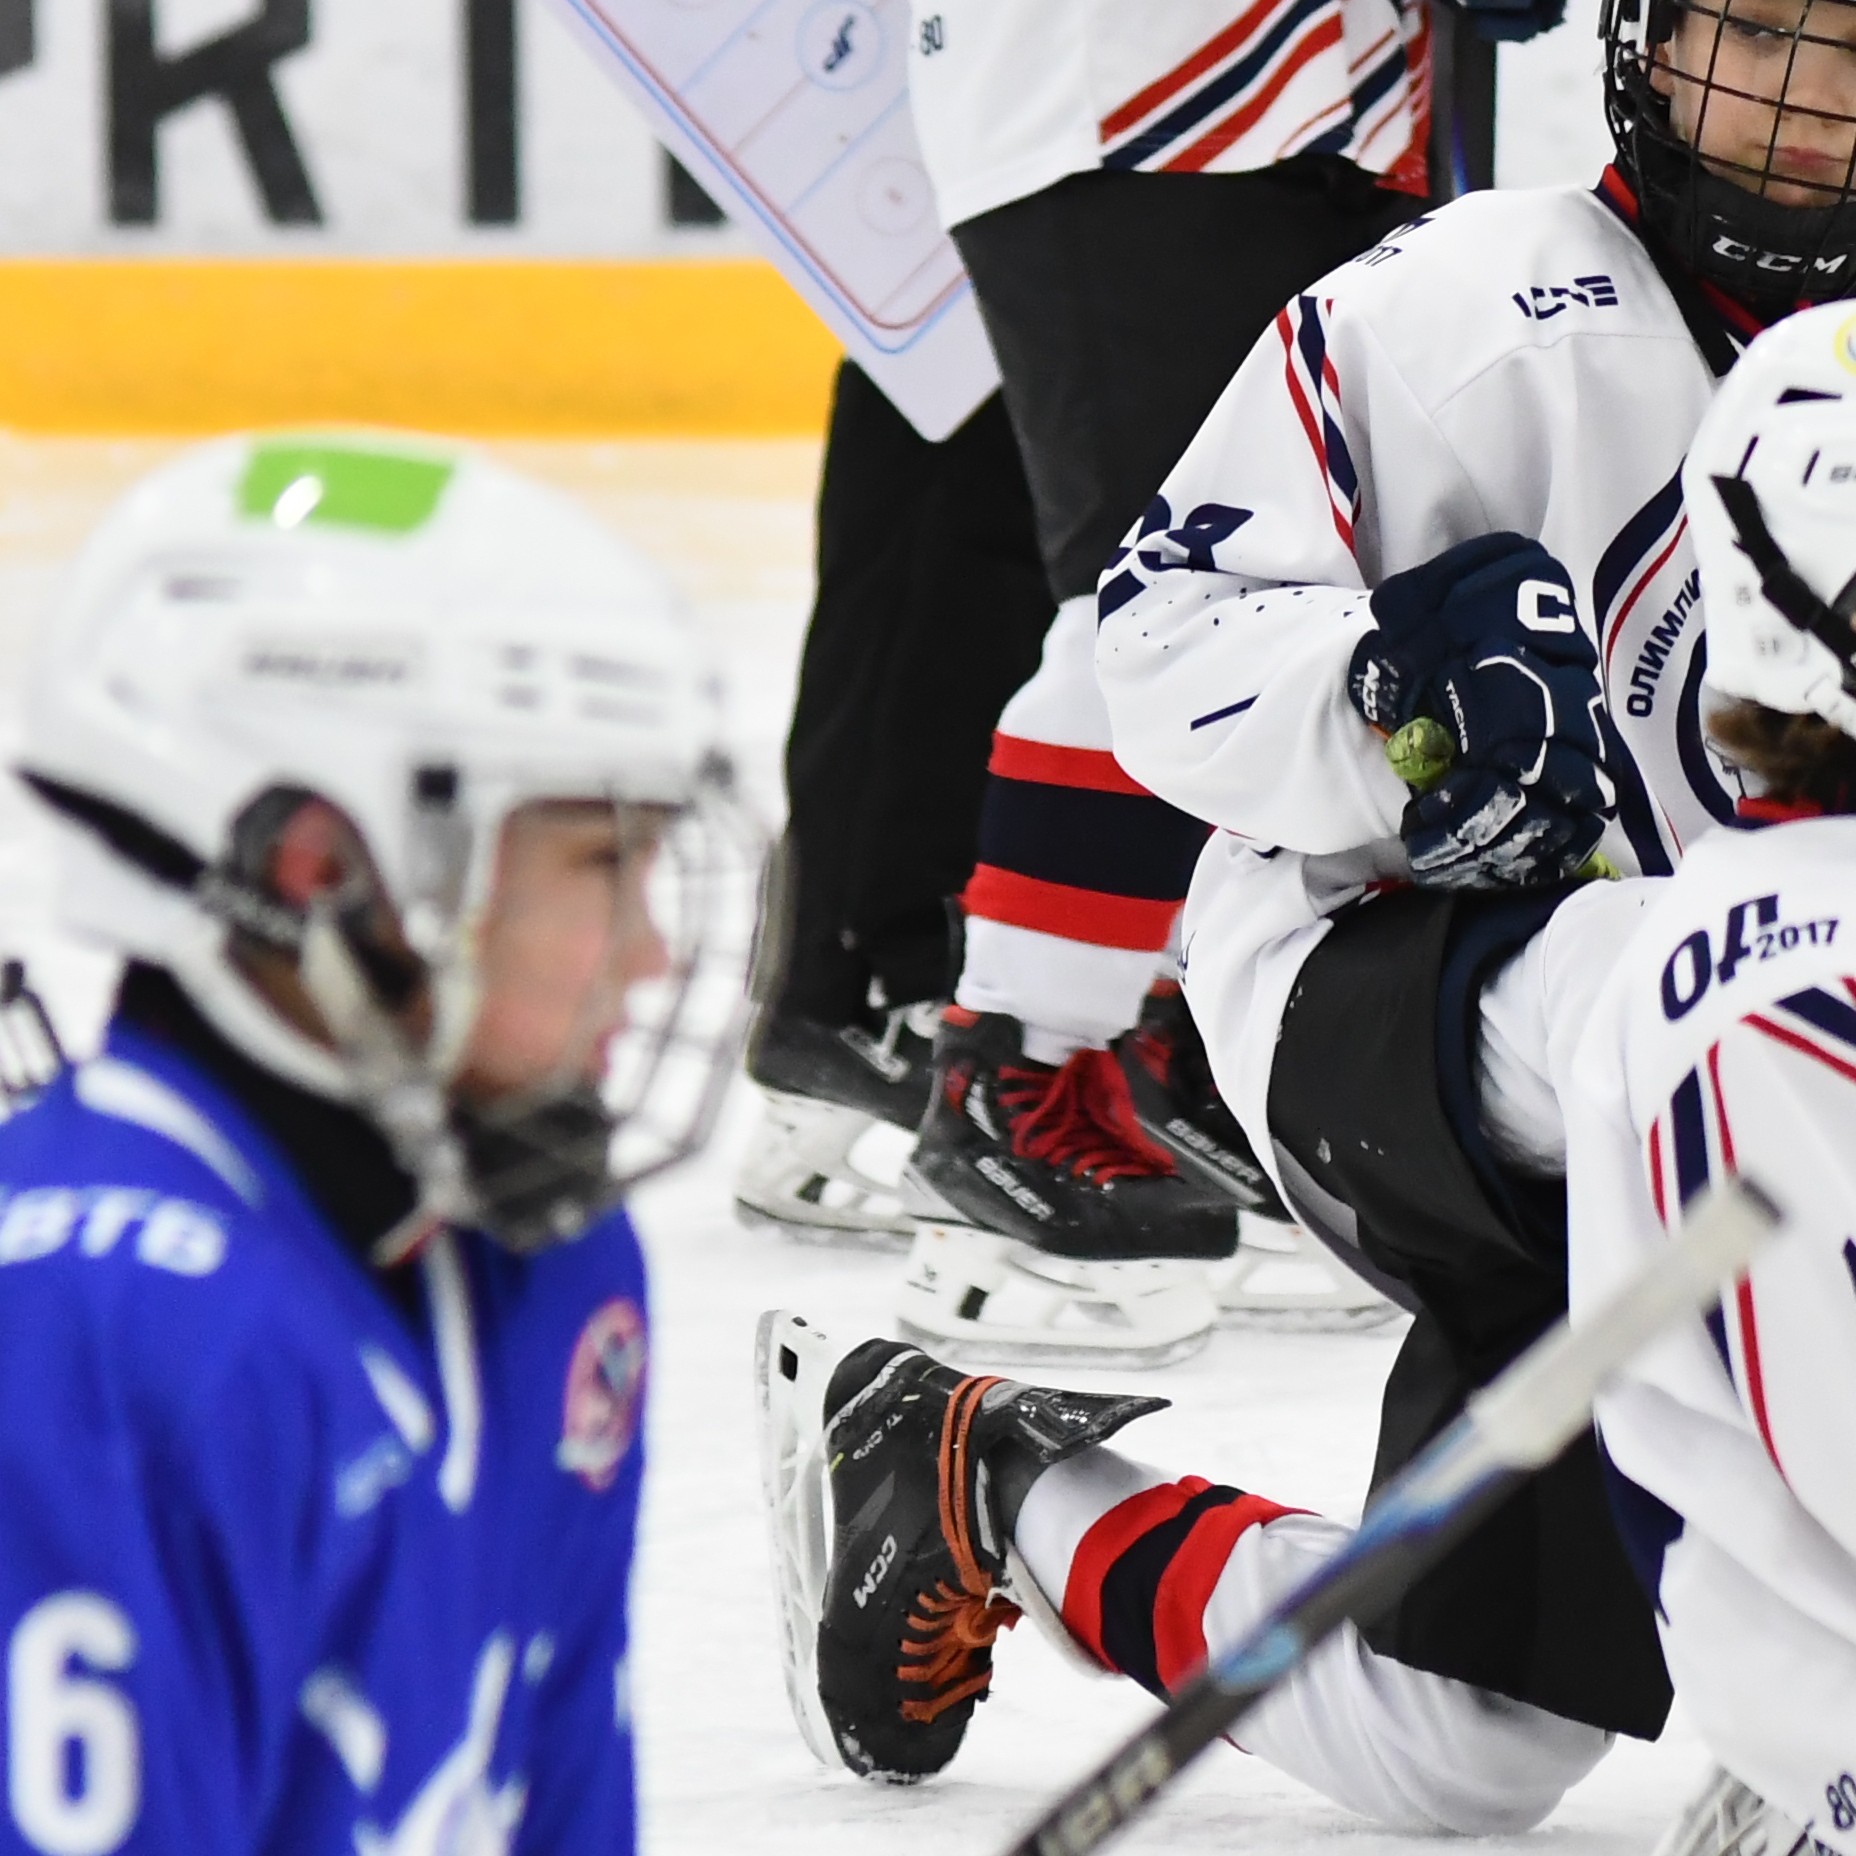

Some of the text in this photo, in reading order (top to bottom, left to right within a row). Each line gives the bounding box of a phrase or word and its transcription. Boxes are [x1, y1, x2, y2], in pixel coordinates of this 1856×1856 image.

[1711, 231, 1849, 277] CCM
[1444, 678, 1470, 755] TACKS
[1757, 919, 1839, 962] 2017
[854, 1534, 899, 1609] CCM
